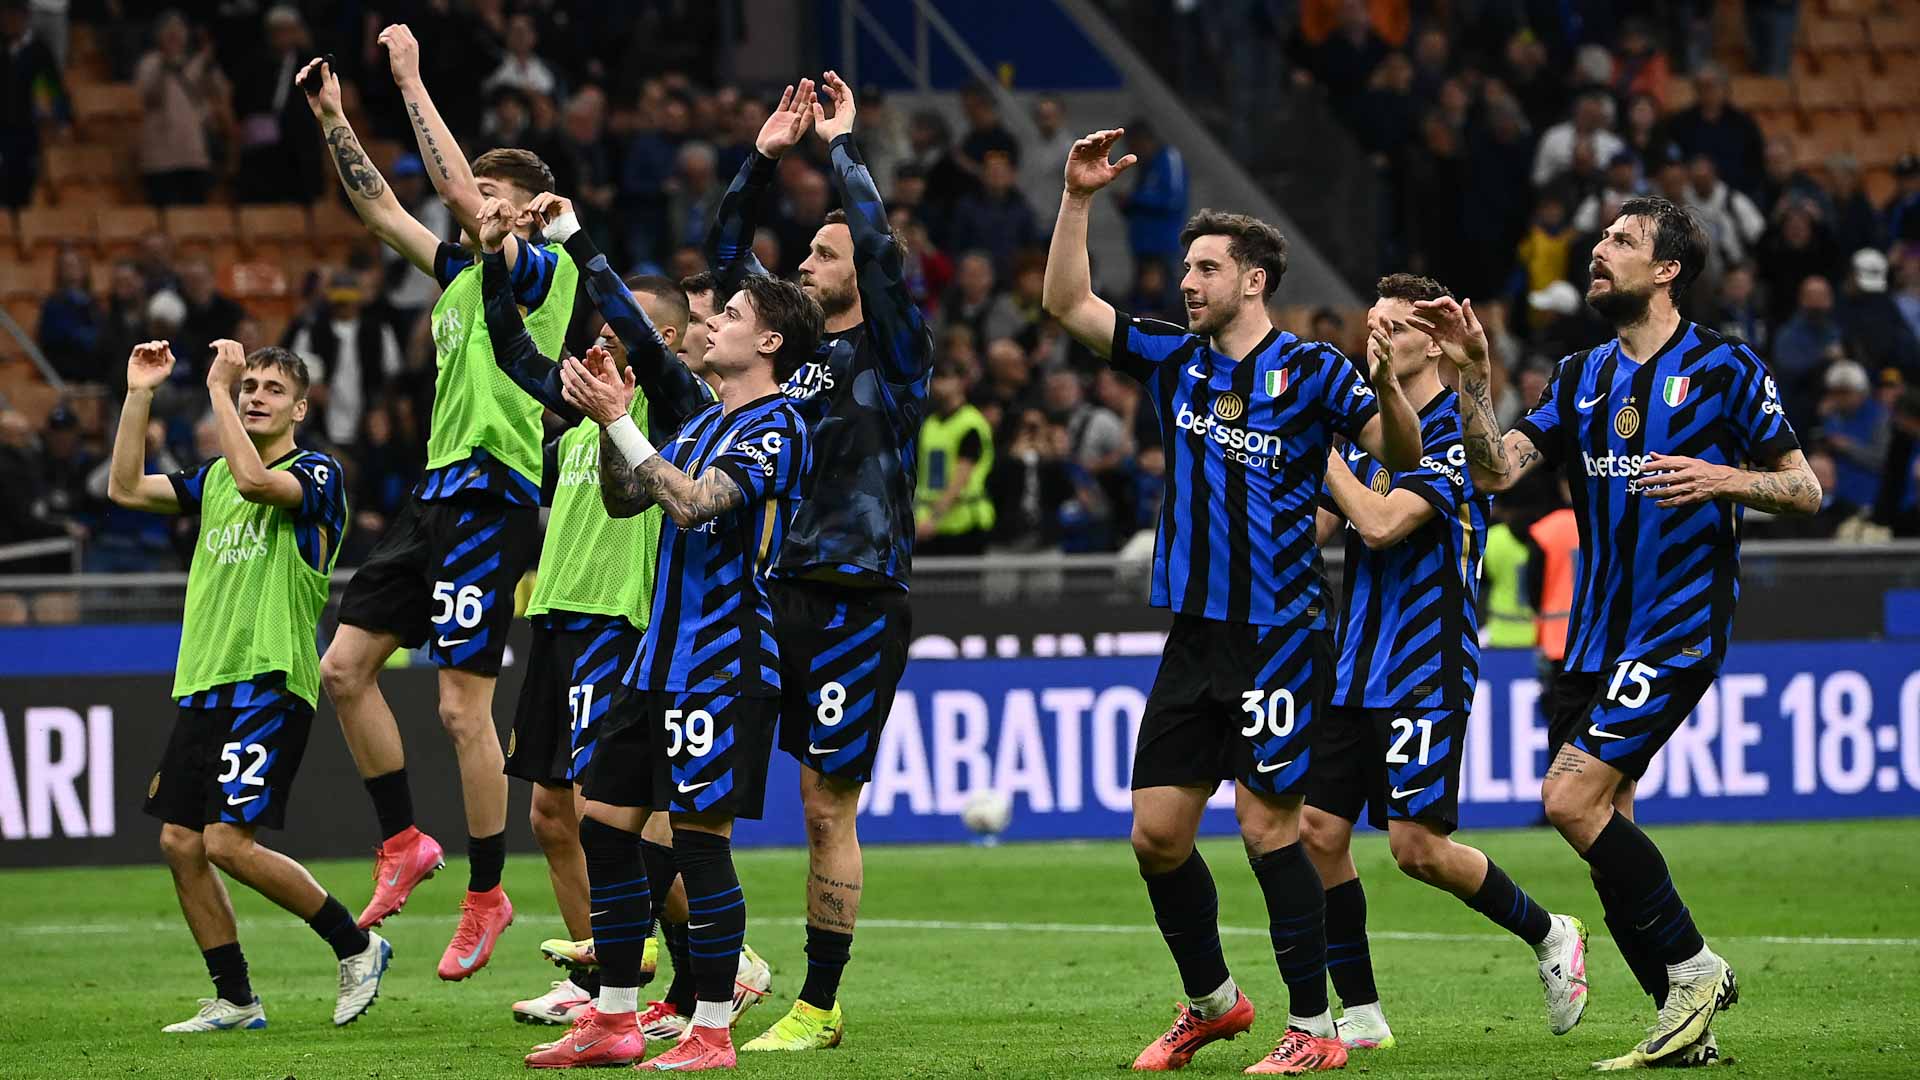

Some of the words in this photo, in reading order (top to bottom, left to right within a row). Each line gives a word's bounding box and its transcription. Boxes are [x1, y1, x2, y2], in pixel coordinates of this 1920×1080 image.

[1176, 402, 1281, 456] betsson
[737, 440, 775, 477] Gate.io
[1419, 456, 1465, 486] Gate.io
[1582, 449, 1675, 477] betss
[430, 580, 483, 629] 56
[568, 684, 594, 731] 51
[816, 681, 847, 727] 8
[1606, 660, 1658, 709] 15
[664, 709, 714, 757] 59
[1241, 688, 1295, 737] 30
[217, 742, 268, 786] 52
[857, 685, 1149, 817] ABATO
[1386, 717, 1433, 766] 21
